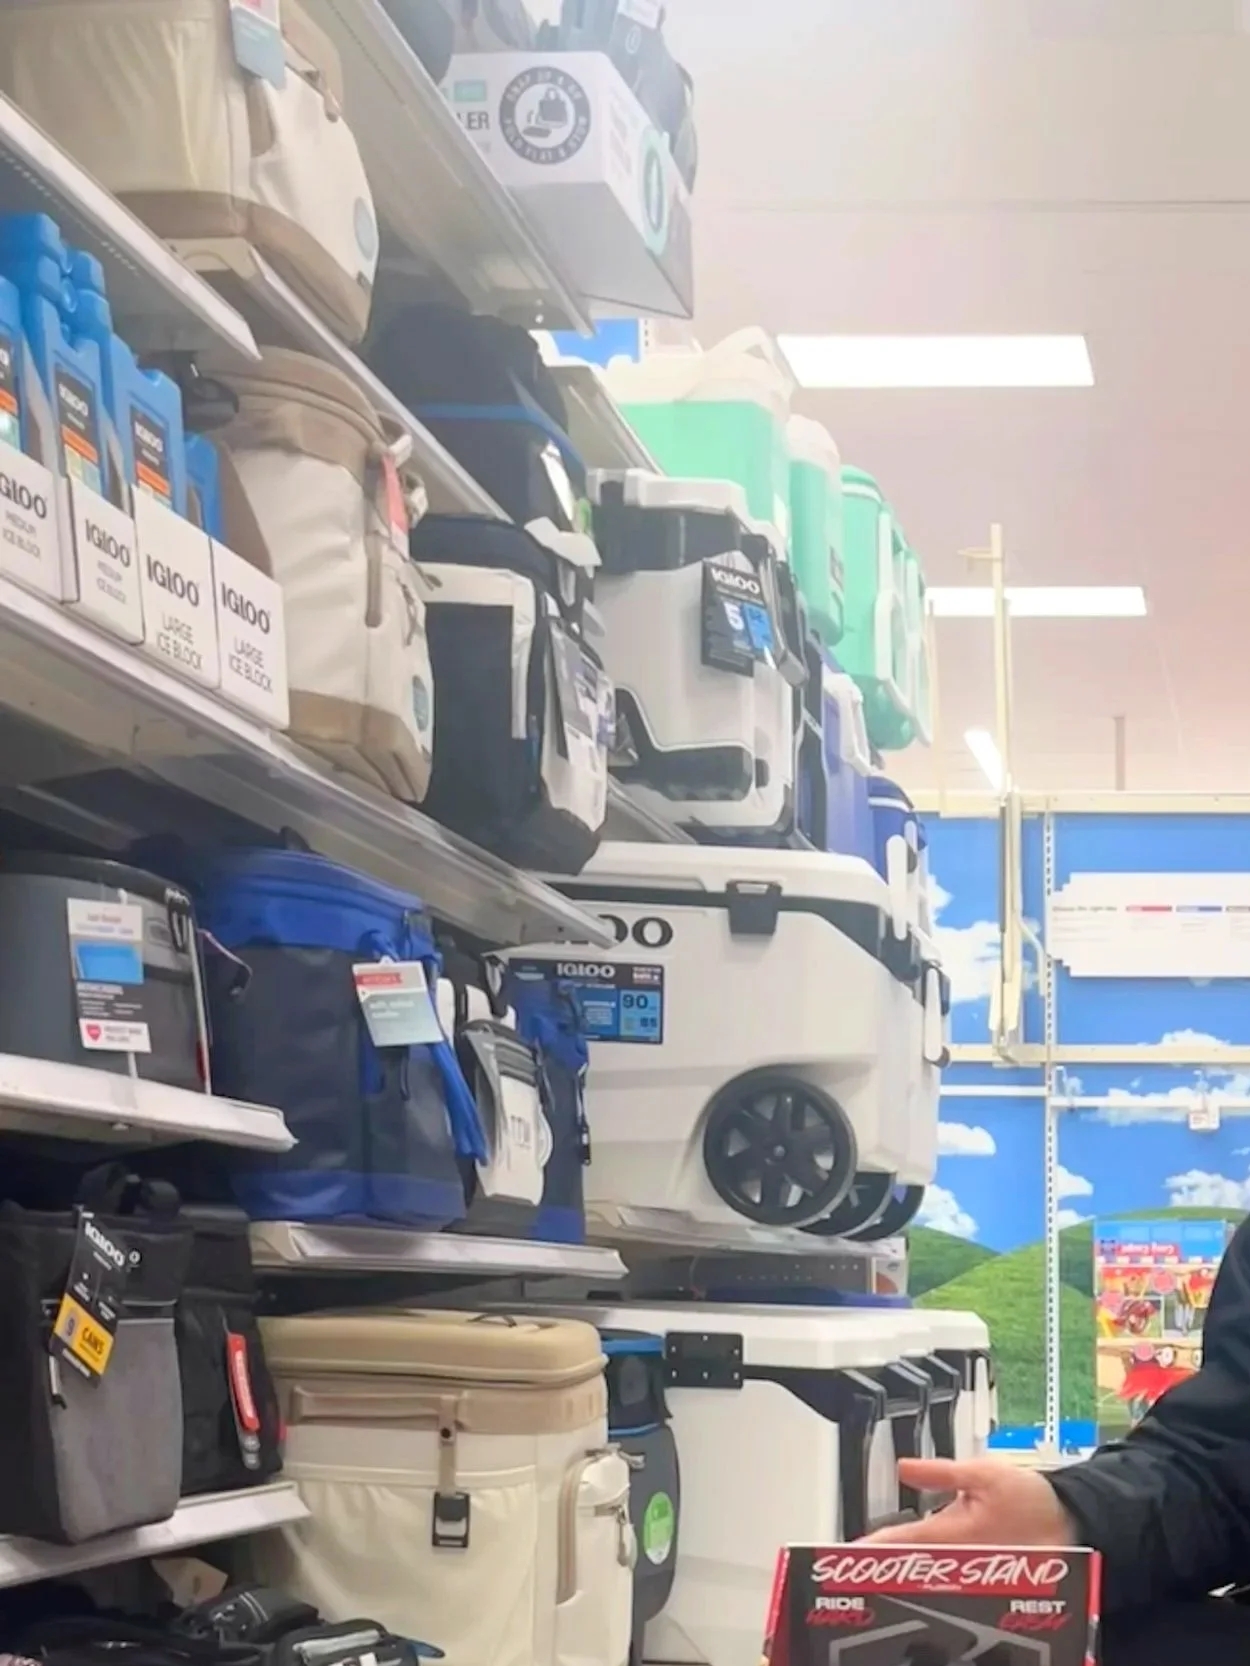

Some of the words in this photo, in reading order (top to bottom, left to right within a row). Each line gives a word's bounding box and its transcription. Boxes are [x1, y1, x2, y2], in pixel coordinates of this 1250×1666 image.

[85, 518, 131, 568] IGLOO
[146, 554, 200, 607] IGLOO
[711, 567, 760, 594] IGLOO
[221, 582, 271, 634] IGLOO
[161, 615, 194, 645] LARGE
[156, 632, 172, 653] ICE
[172, 640, 204, 671] BLOCK
[233, 637, 265, 670] LARGE
[228, 655, 244, 677] ICE
[244, 662, 274, 694] BLOCK
[557, 963, 616, 978] IGLOO
[623, 994, 649, 1009] 90
[85, 1222, 125, 1267] IGLOO
[811, 1553, 959, 1584] SCOOTER
[959, 1554, 1069, 1588] STAND
[815, 1597, 866, 1611] RIDE
[1010, 1600, 1067, 1614] REST
